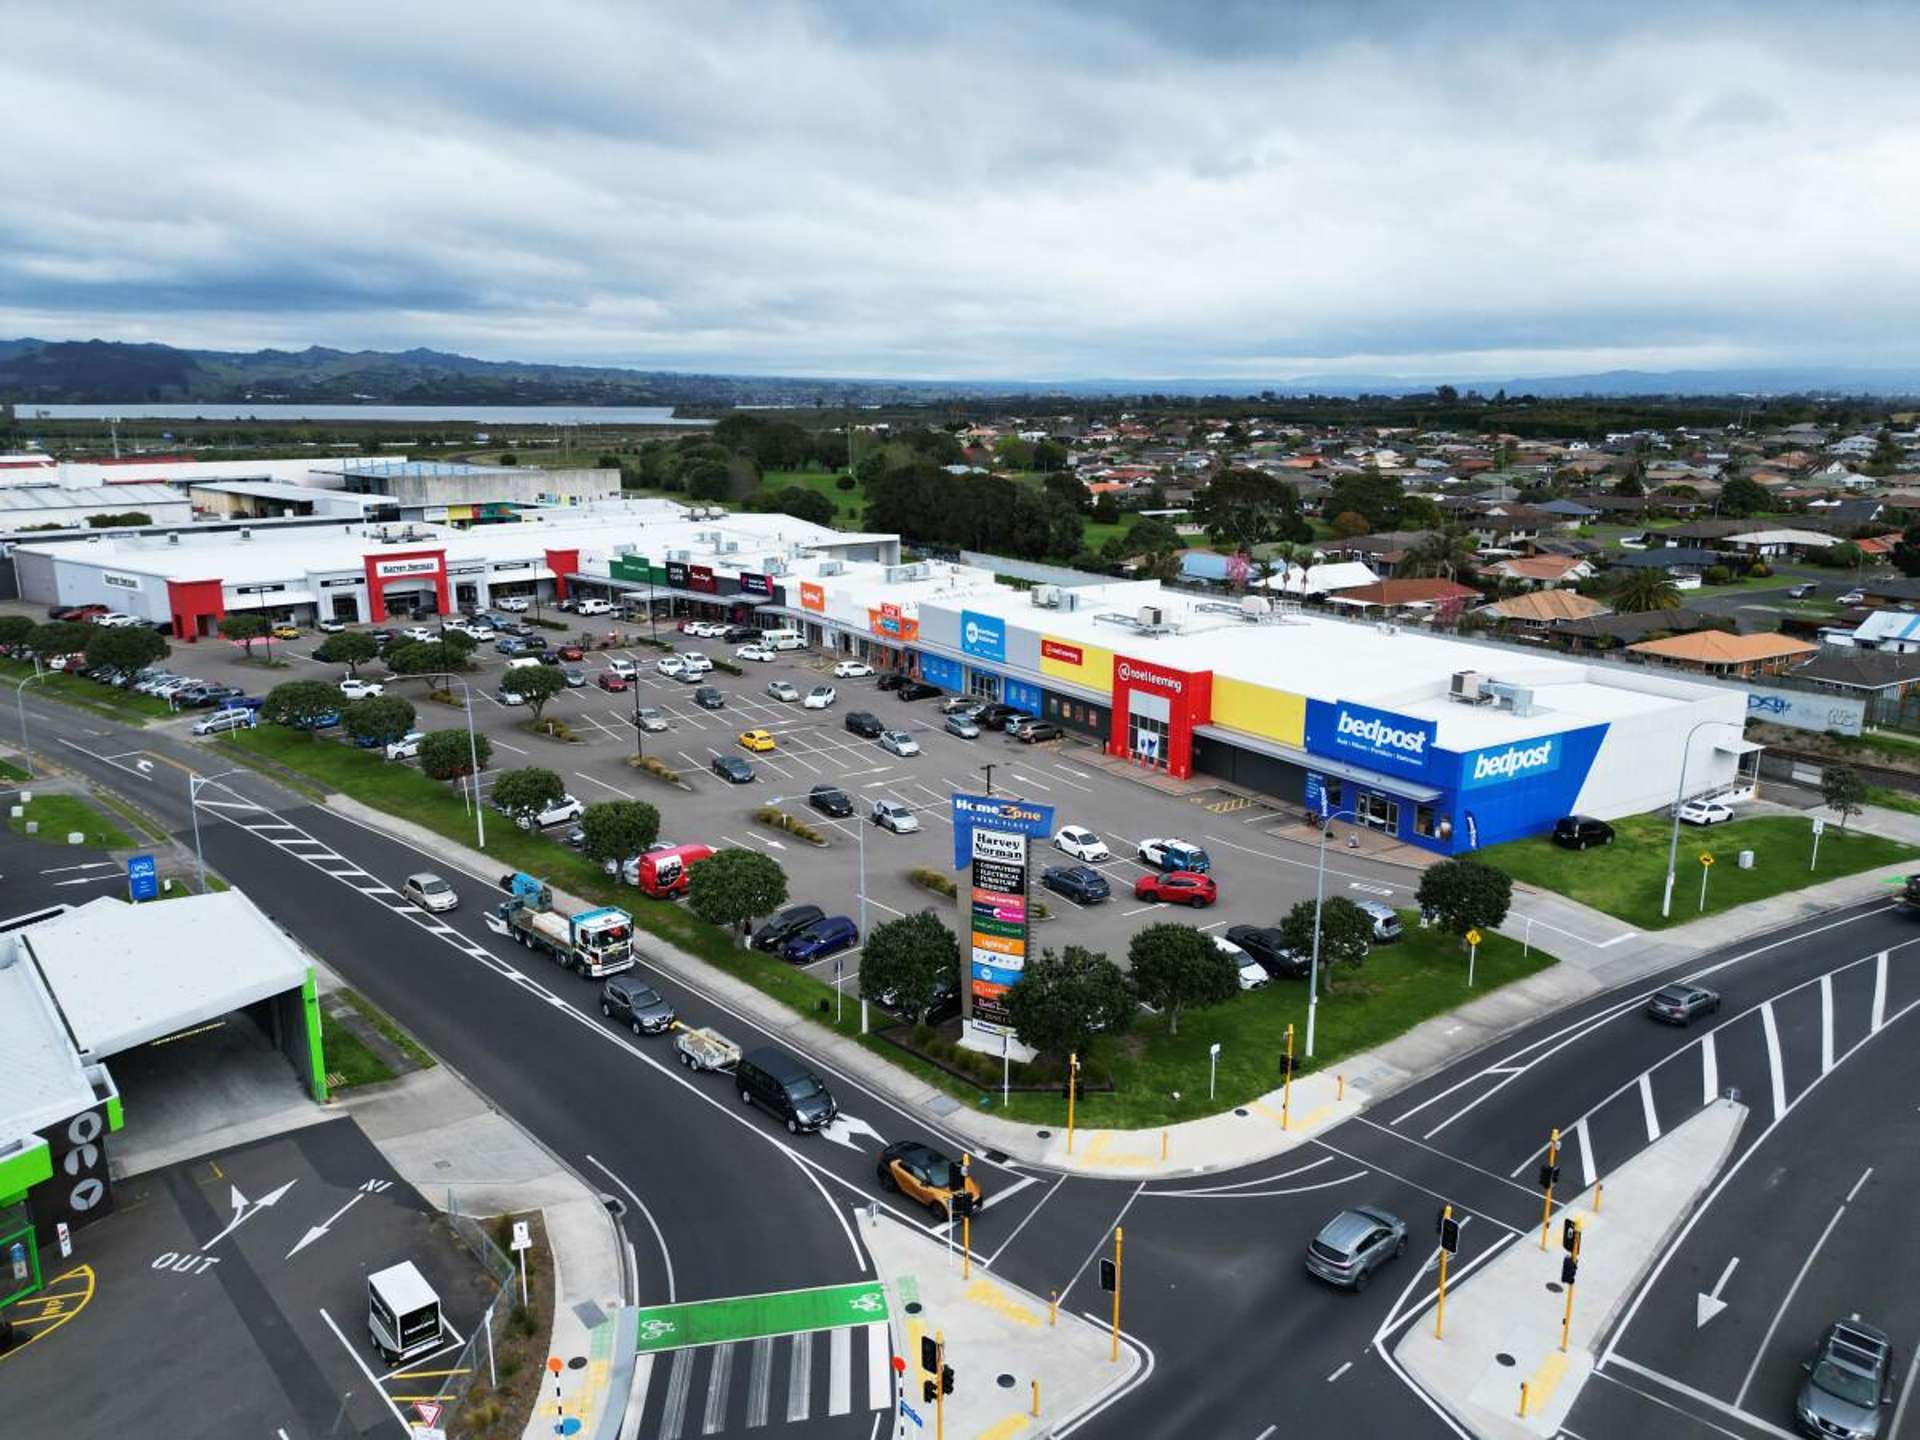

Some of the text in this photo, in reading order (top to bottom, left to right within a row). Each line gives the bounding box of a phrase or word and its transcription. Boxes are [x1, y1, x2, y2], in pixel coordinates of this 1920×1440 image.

[1337, 710, 1426, 753] bedpost
[1473, 740, 1552, 779] bedpost
[976, 832, 1020, 850] Harvey
[976, 843, 1022, 859] Norman
[151, 1252, 221, 1275] OUT
